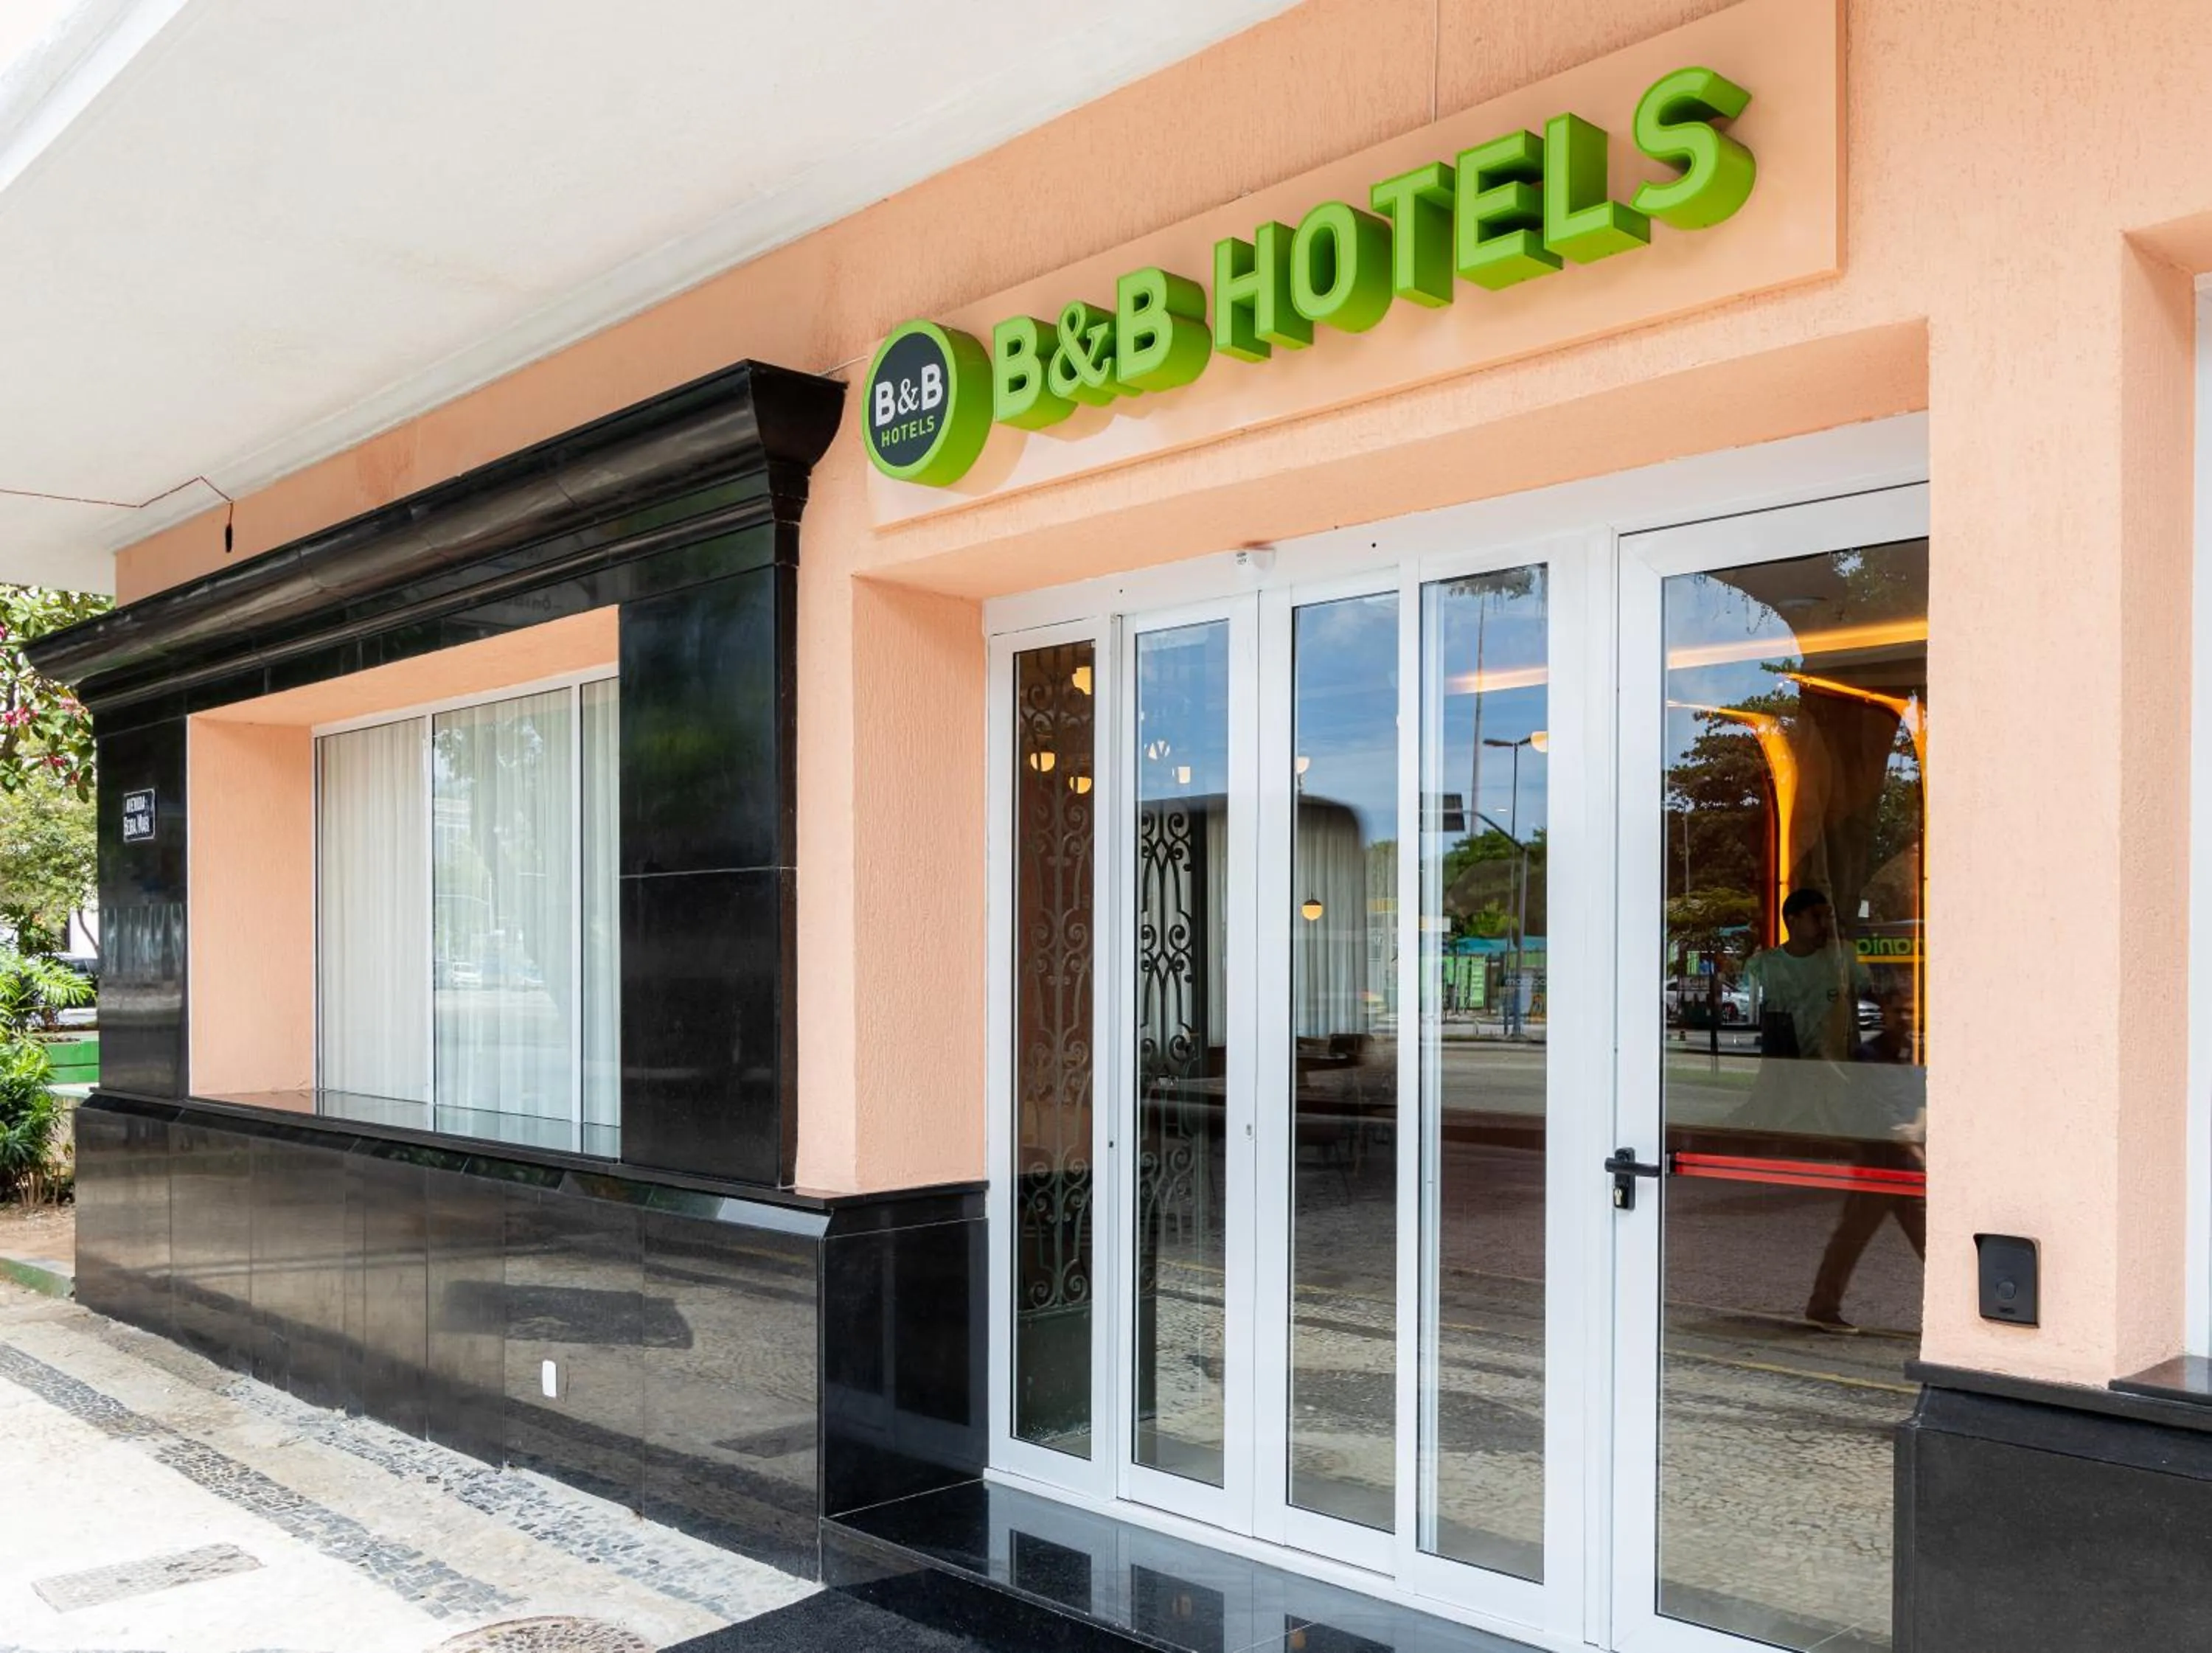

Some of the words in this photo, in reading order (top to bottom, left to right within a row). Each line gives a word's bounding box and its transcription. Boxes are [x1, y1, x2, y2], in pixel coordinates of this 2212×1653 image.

[992, 266, 1211, 432] B&B
[1214, 66, 1756, 363] HOTELS
[875, 363, 943, 427] B&B
[881, 415, 935, 448] HOTELS
